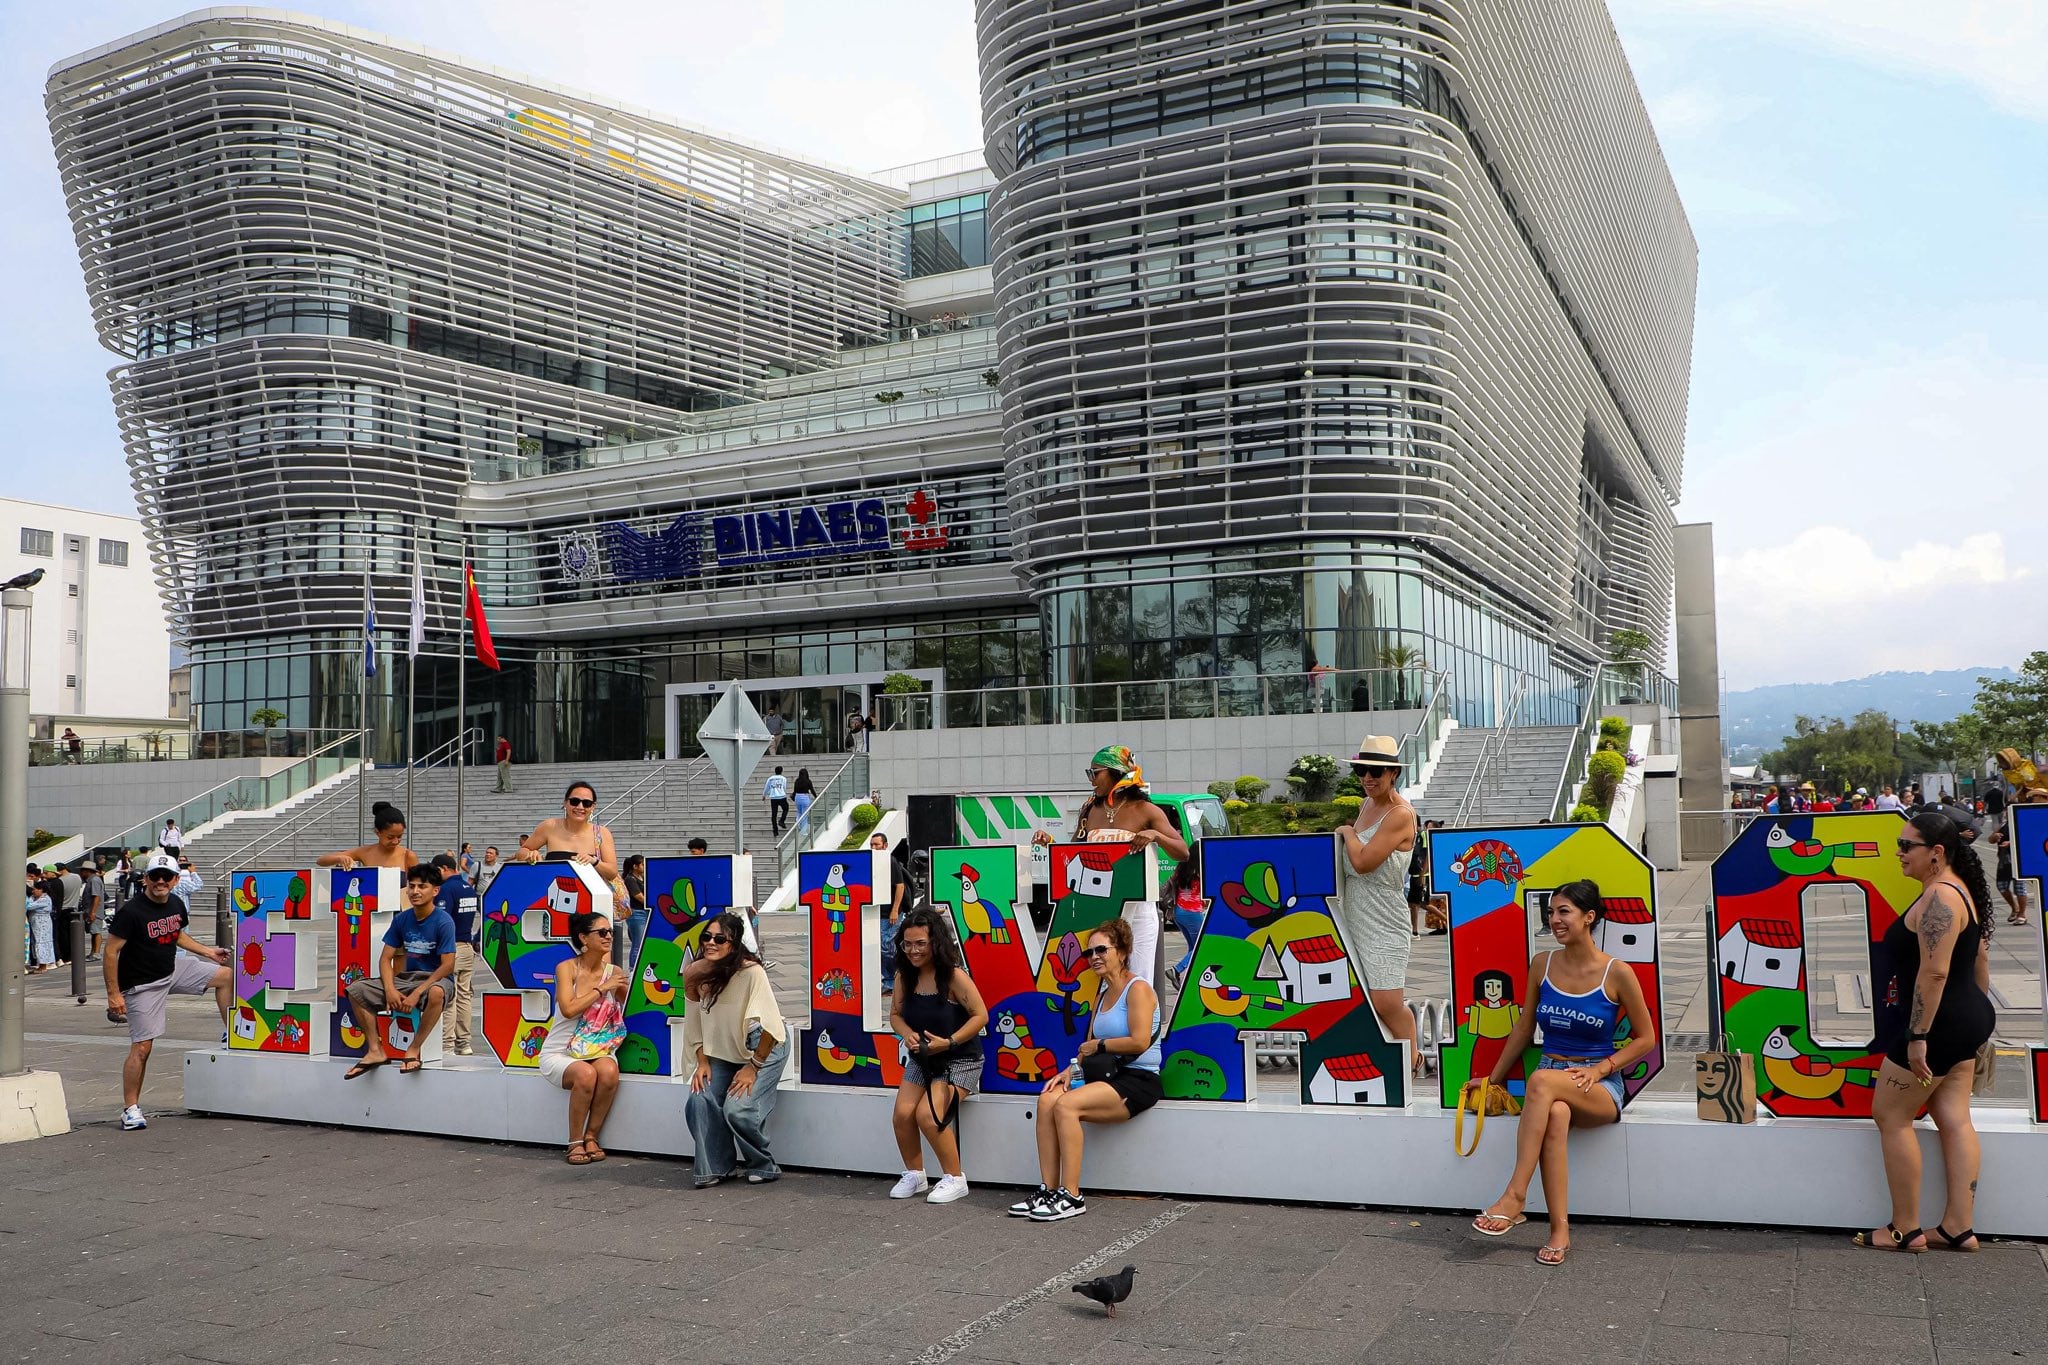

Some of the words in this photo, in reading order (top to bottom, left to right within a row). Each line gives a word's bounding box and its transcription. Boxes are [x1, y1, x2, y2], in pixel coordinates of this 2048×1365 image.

[712, 499, 889, 555] BINAES
[227, 866, 424, 1062] EL
[481, 803, 2048, 1125] SALVADO
[1540, 1004, 1604, 1029] SALVADOR
